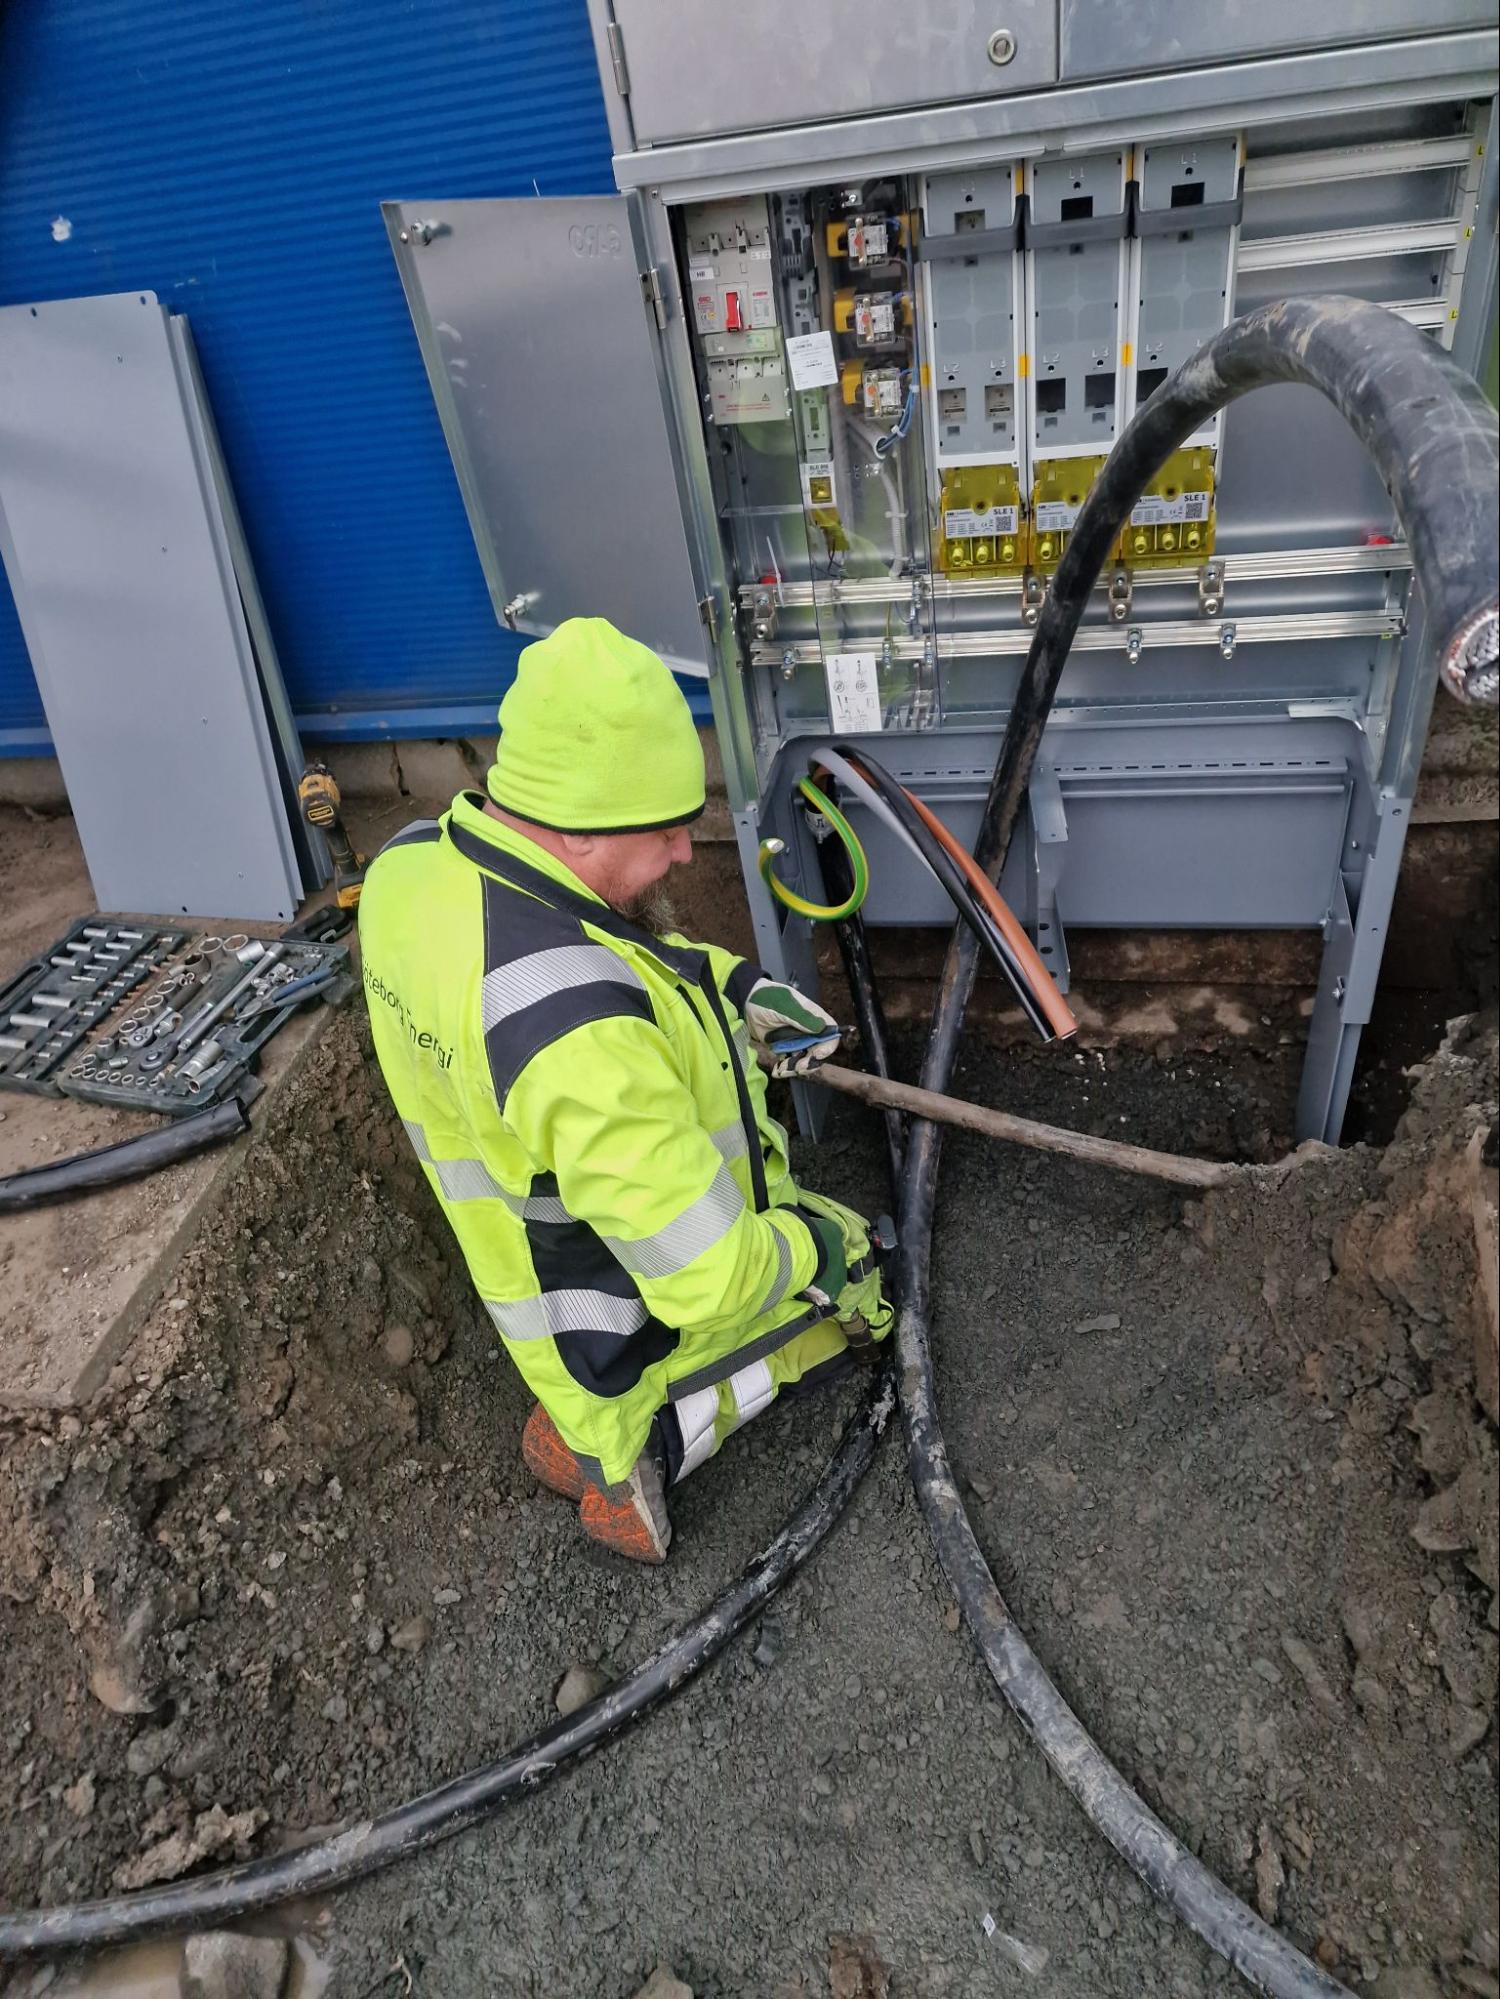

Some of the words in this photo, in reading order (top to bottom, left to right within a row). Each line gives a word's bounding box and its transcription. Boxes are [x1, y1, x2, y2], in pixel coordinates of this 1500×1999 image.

[1043, 352, 1060, 364] L2
[1092, 347, 1109, 359] L3
[1184, 494, 1200, 502] SLE
[362, 958, 404, 1027] öteborg
[406, 1007, 455, 1070] nergi
